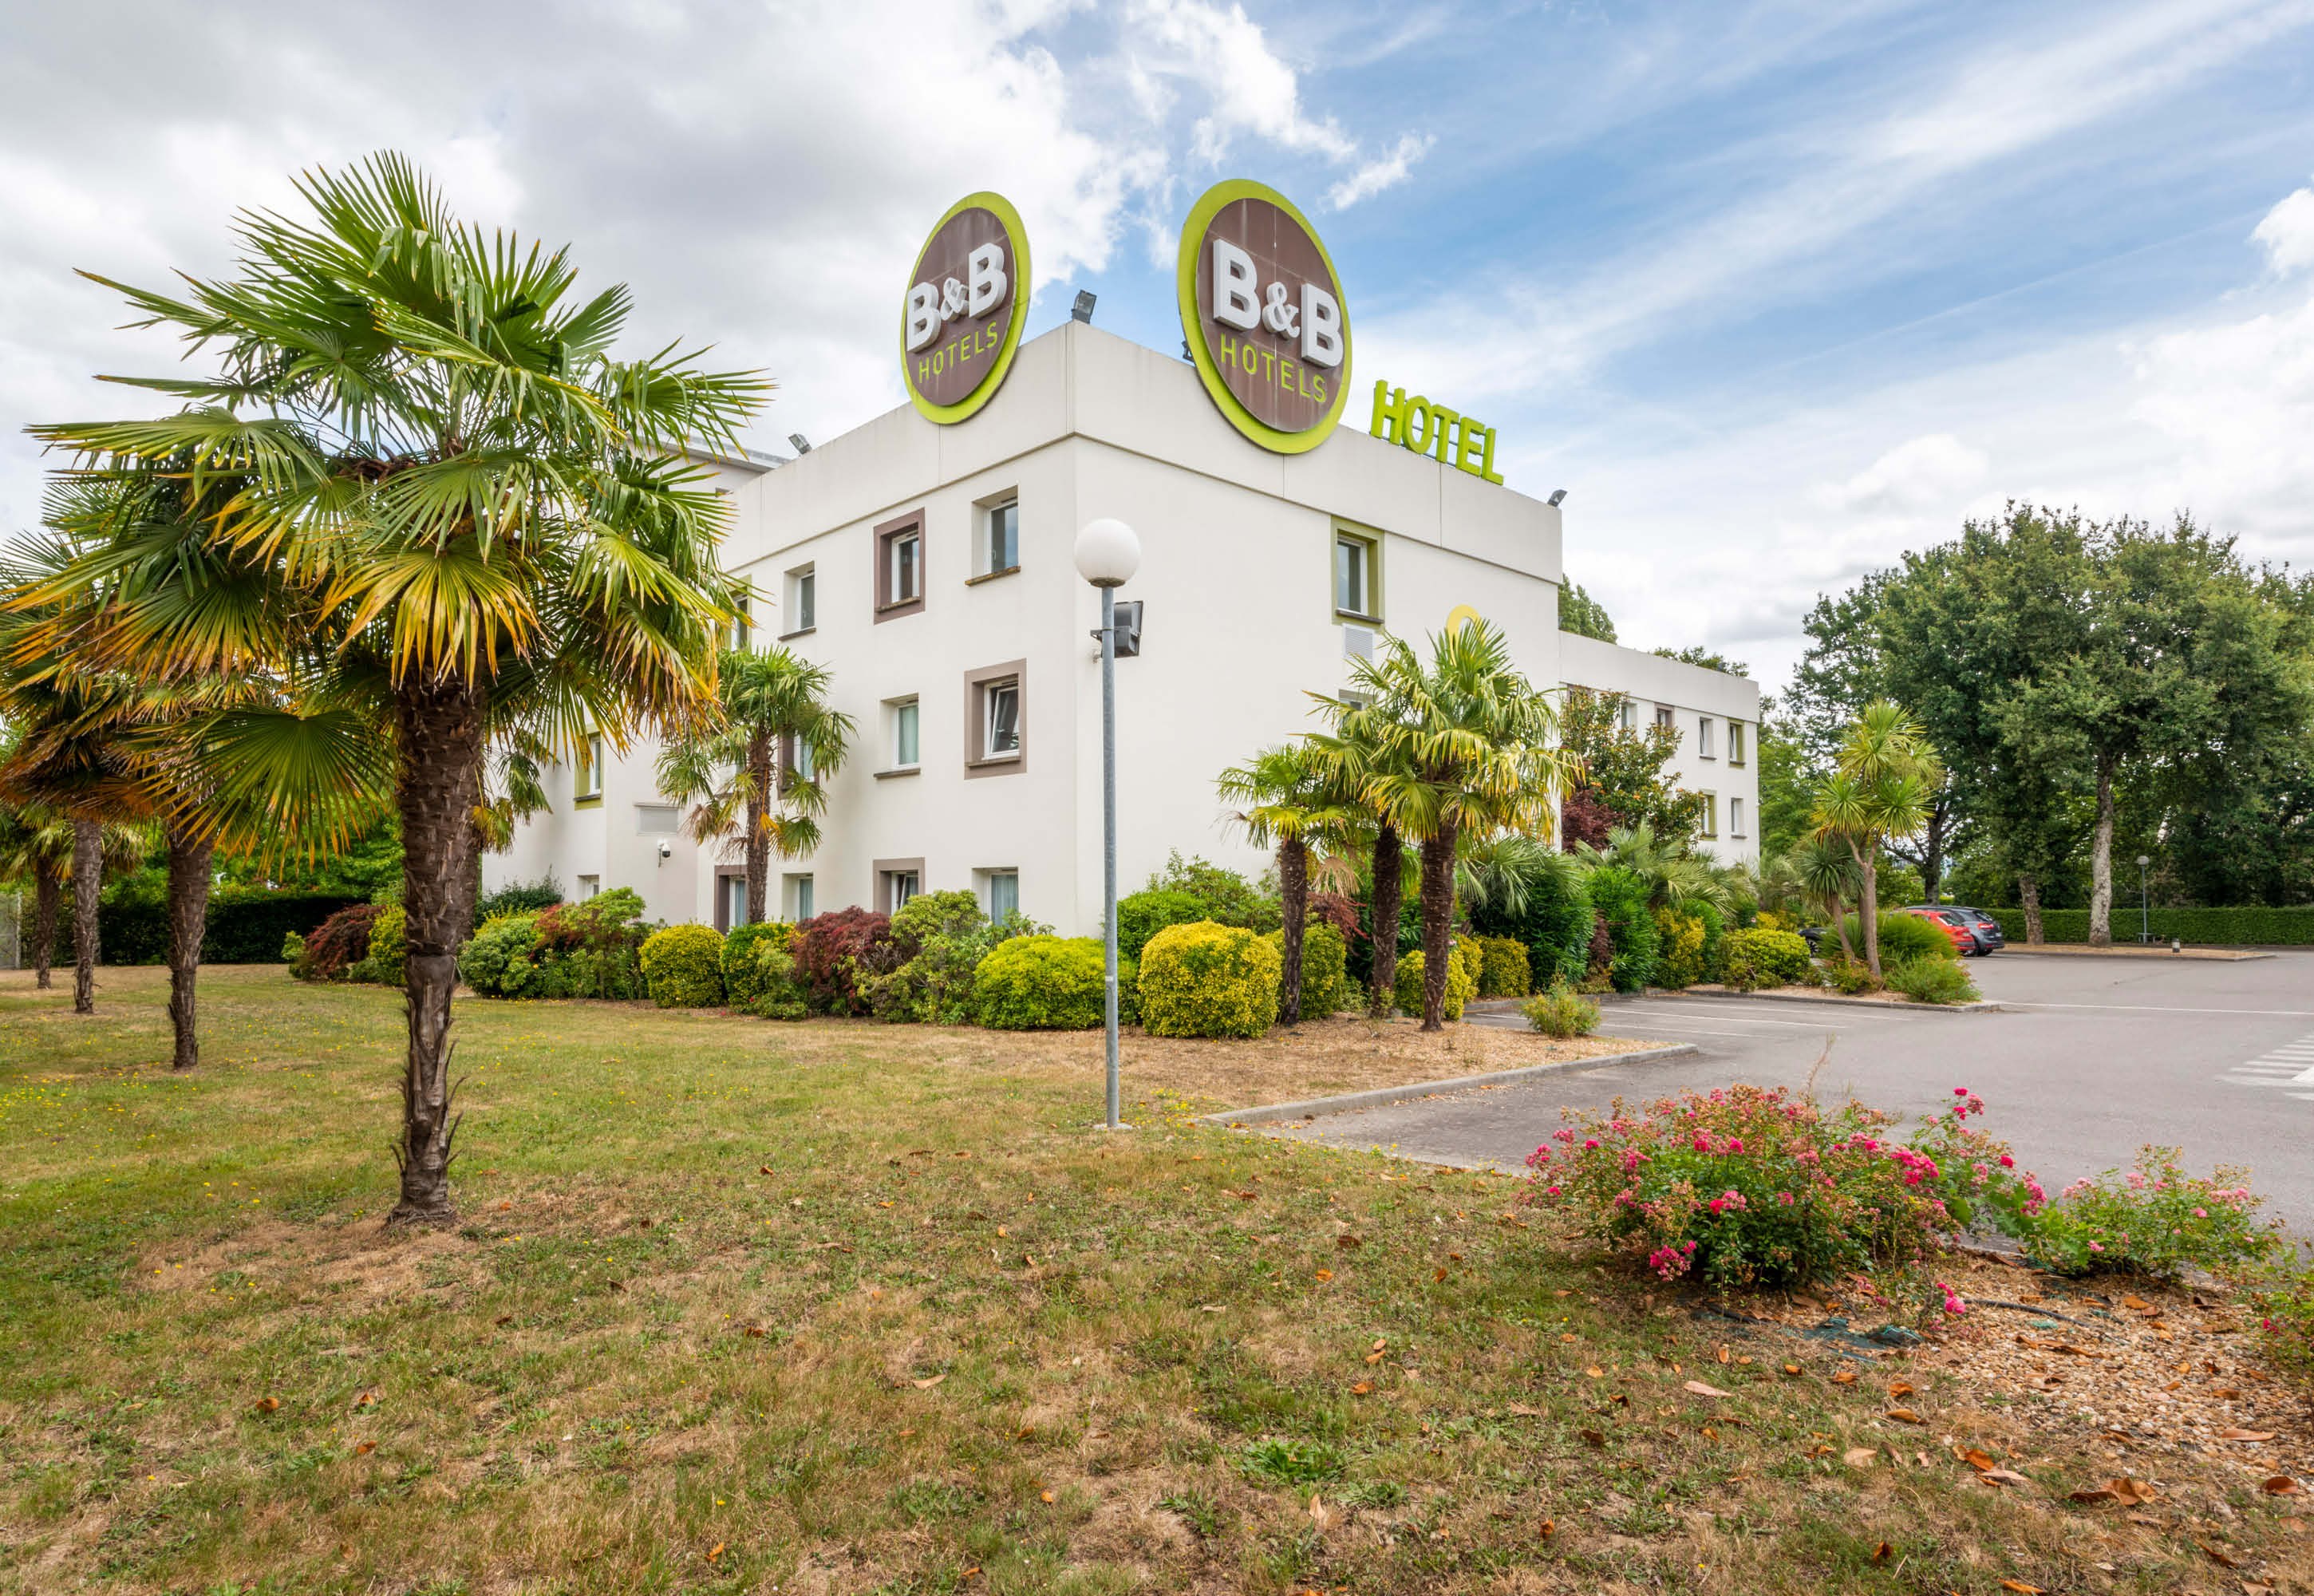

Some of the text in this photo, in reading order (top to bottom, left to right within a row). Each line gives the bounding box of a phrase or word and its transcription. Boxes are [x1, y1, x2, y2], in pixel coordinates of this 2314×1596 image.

[906, 242, 1008, 352] B&B
[1213, 239, 1344, 368] B&B
[918, 321, 998, 383] HOTELS
[1220, 332, 1327, 403] HOTELS
[1370, 379, 1504, 486] HOTEL
